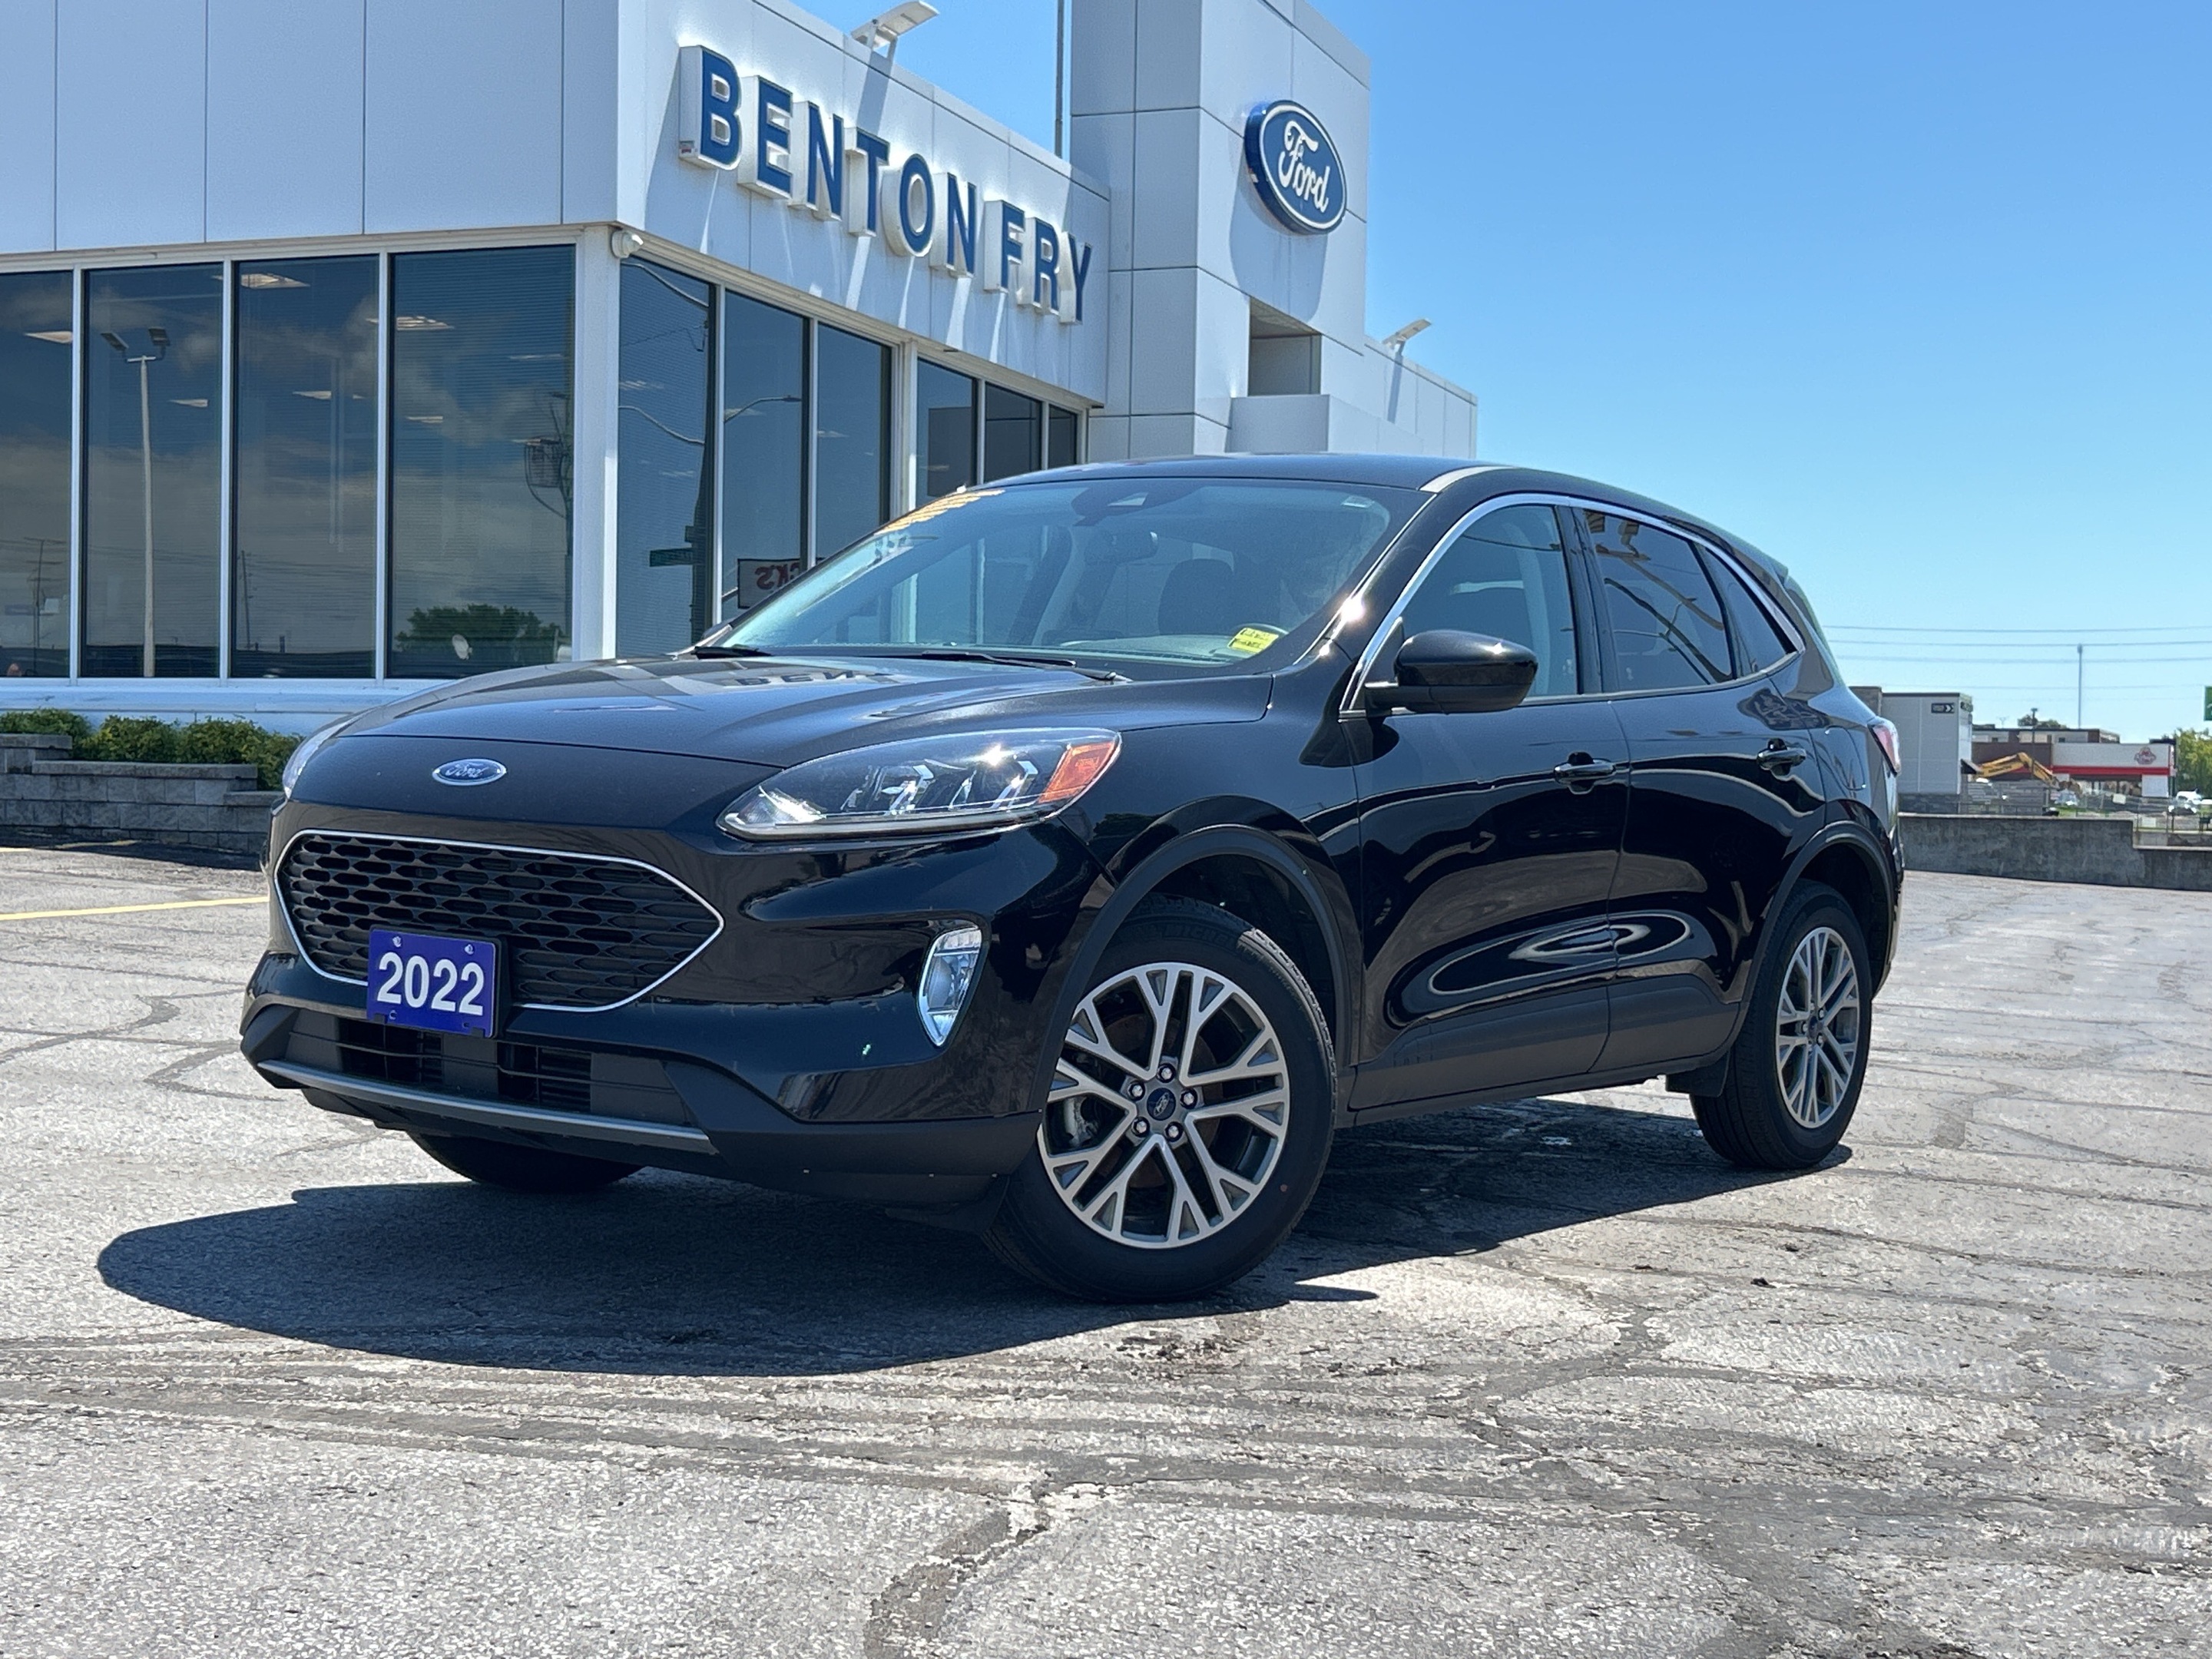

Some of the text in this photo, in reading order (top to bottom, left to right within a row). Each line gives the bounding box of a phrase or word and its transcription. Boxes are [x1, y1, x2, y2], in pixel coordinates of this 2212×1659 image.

[697, 44, 1092, 323] BENTON FRY
[1278, 120, 1330, 214] Ford
[445, 762, 489, 779] Ford
[376, 952, 485, 1016] 2022
